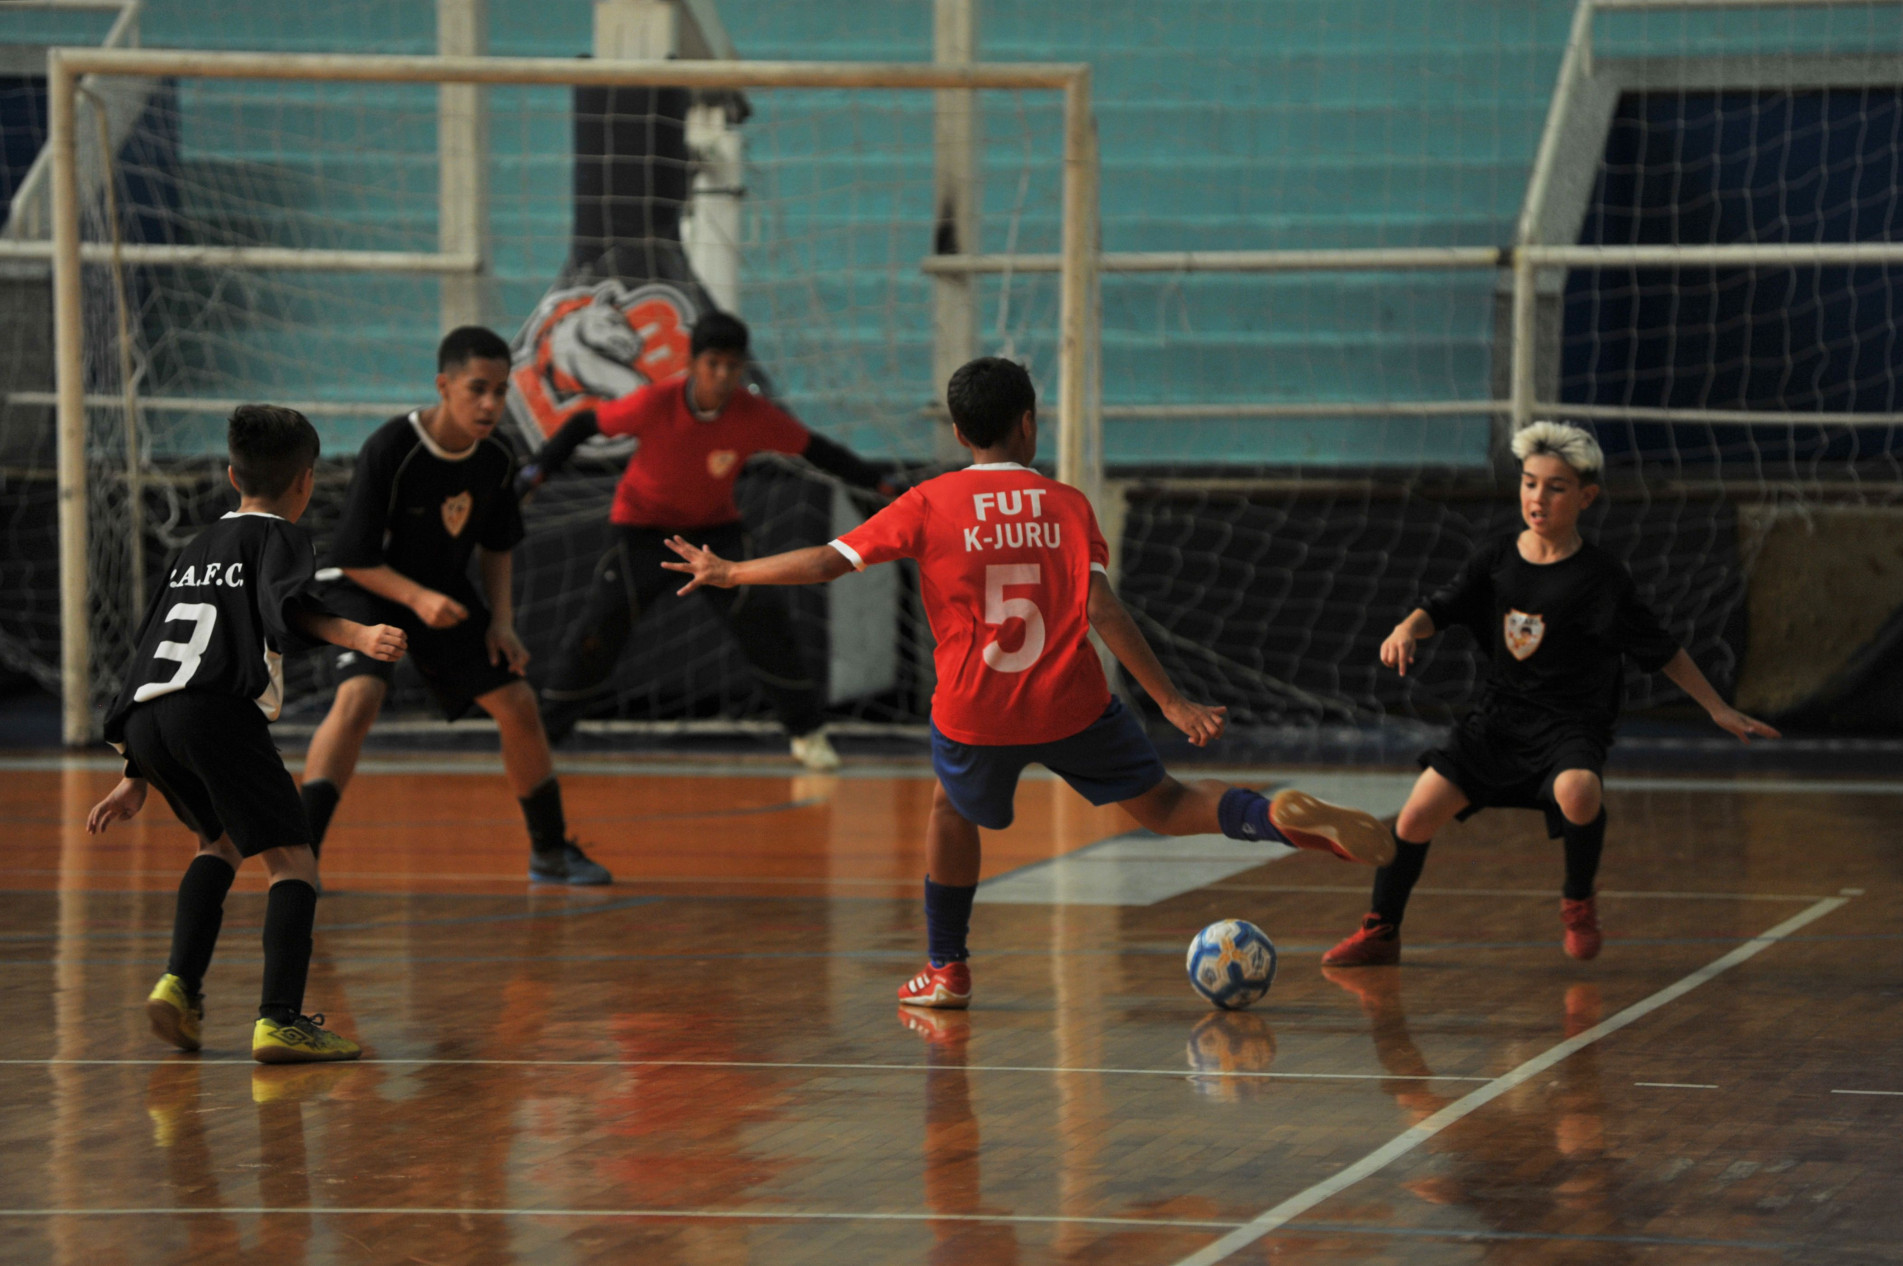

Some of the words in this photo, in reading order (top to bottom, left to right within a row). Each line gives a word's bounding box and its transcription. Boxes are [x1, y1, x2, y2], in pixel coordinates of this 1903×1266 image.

[964, 522, 1061, 552] K-JURU
[973, 489, 1046, 521] FUT
[983, 563, 1045, 672] 5
[133, 603, 217, 702] 3
